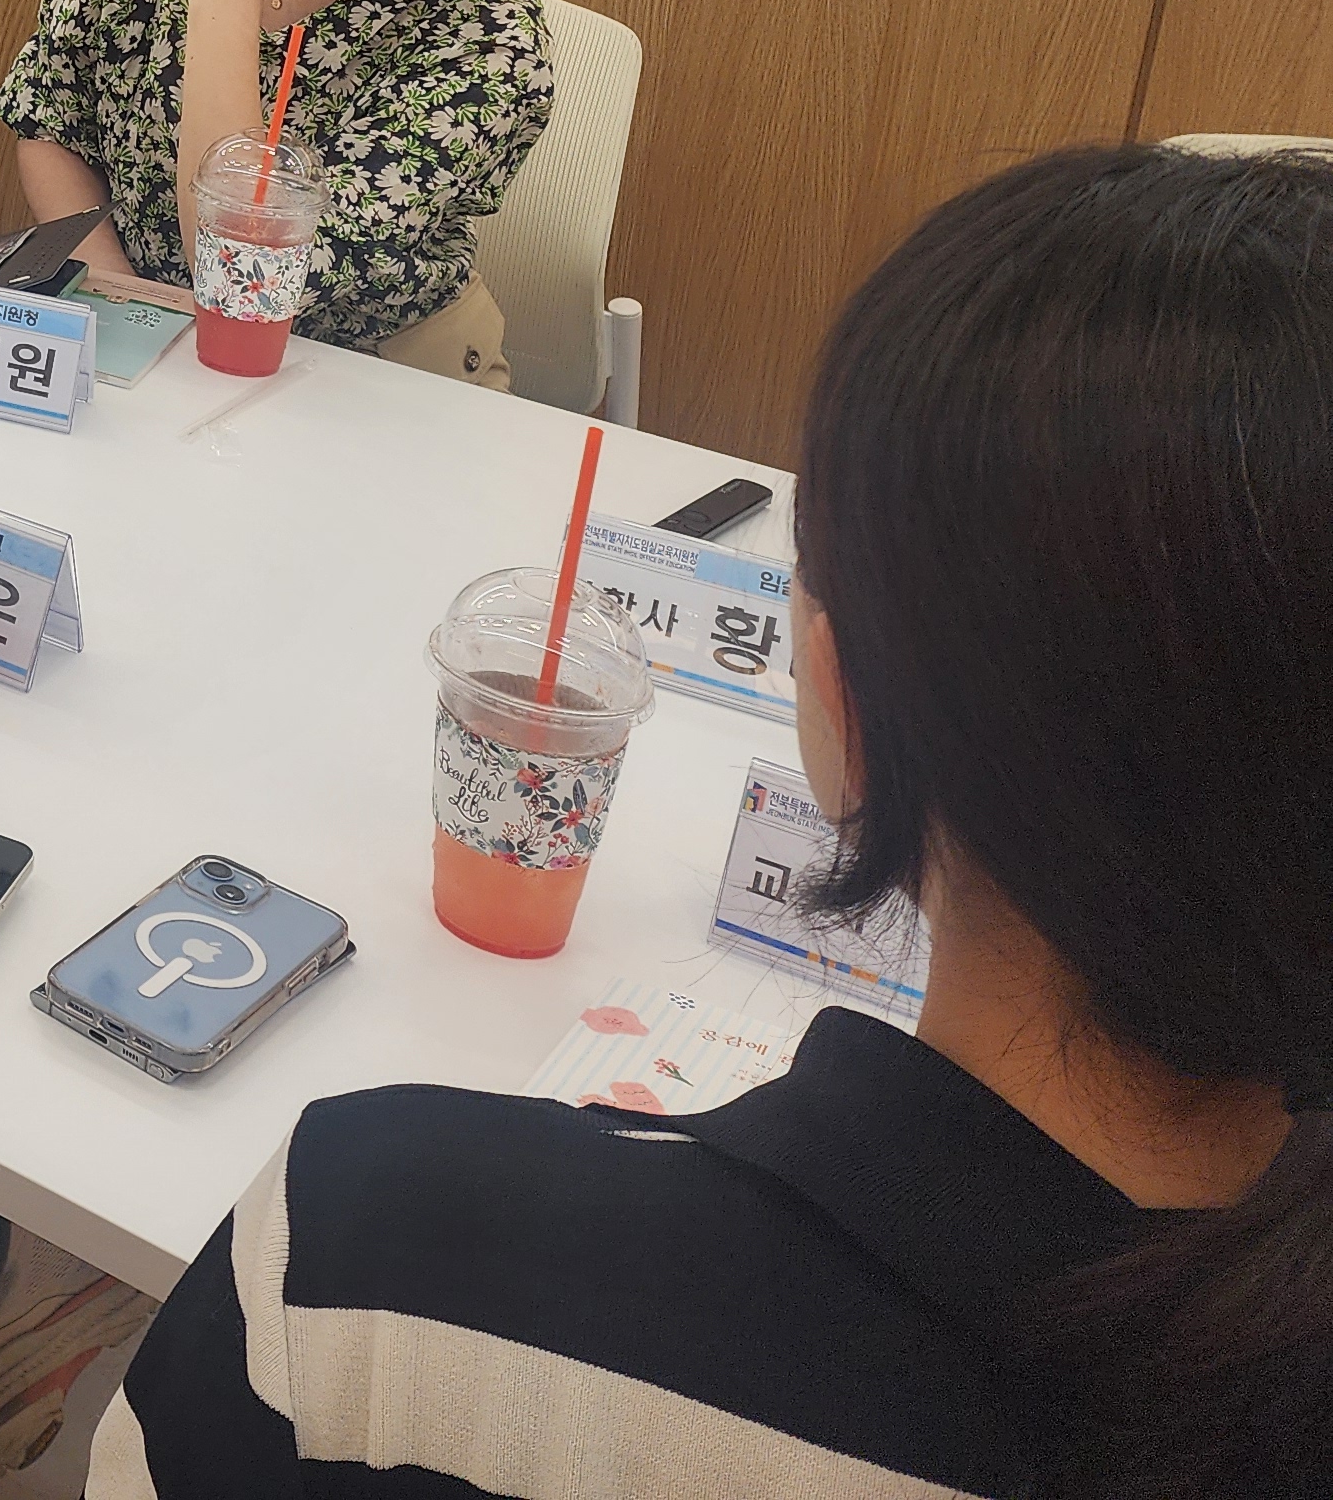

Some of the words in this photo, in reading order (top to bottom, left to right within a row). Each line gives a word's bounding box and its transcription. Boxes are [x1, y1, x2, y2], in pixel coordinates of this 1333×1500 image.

[711, 603, 785, 676] 황
[439, 745, 508, 802] Beautiful
[448, 785, 490, 824] Life
[769, 790, 822, 821] 전북특별자
